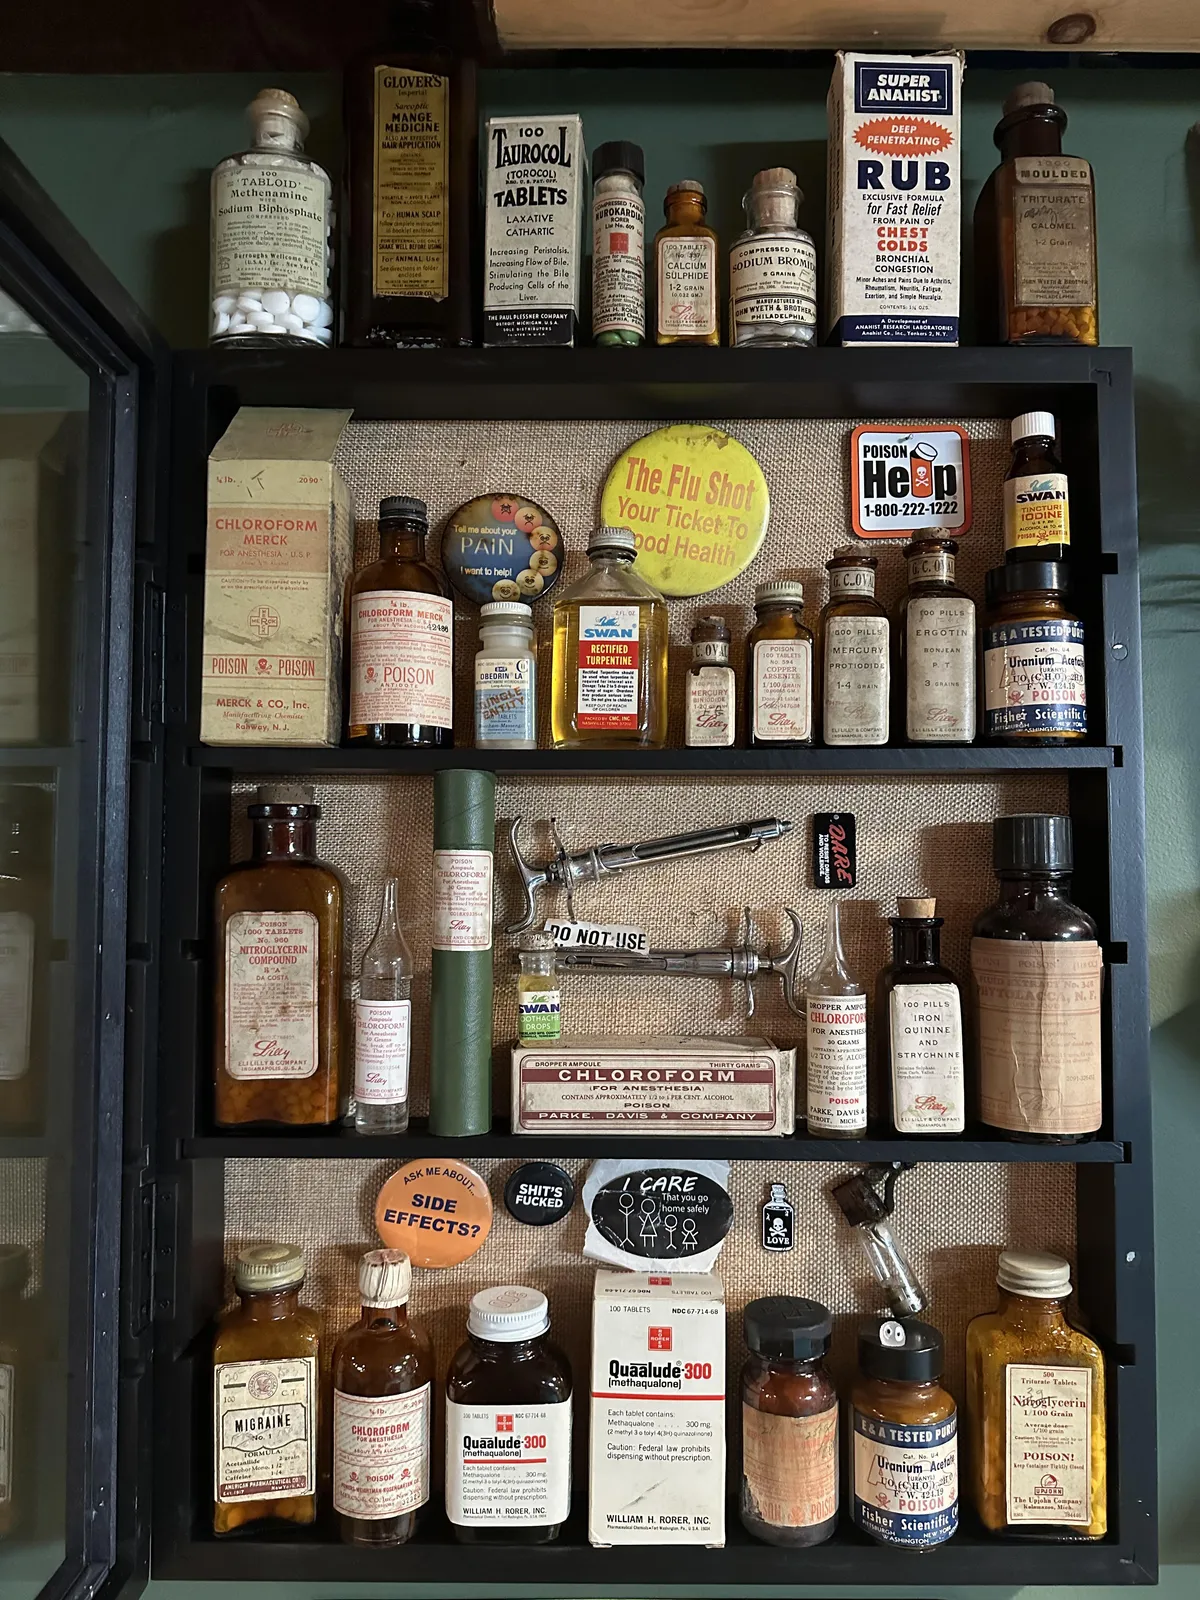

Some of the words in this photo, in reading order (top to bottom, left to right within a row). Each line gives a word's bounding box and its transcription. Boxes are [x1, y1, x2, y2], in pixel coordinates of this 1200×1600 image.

[384, 74, 441, 88] GLOVER'S
[877, 74, 930, 87] SUPER
[867, 88, 939, 102] ANAHIST
[392, 113, 432, 122] MANGE
[385, 123, 439, 132] MEDICINE
[519, 128, 544, 138] 100
[891, 124, 917, 134] DEEP
[867, 135, 940, 146] PENETRATING
[492, 127, 571, 169] TAUROCOL
[506, 169, 556, 180] (TOROCOL)
[857, 160, 951, 191] RUB
[1021, 170, 1087, 178] MOULDED
[231, 189, 308, 202] Methenamine
[494, 187, 567, 208] TABLETS
[862, 194, 903, 202] EXCLUSIVE
[906, 194, 944, 202] FORMULA
[1020, 195, 1085, 204] TRITURATE
[218, 204, 252, 217] Sodium
[258, 204, 322, 222] Biphosphate
[866, 202, 884, 215] for
[886, 202, 908, 214] Fast
[912, 202, 942, 216] Relief
[506, 214, 554, 224] LAXATIVE
[506, 228, 554, 236] CATHARTIC
[876, 227, 929, 238] CHEST
[877, 240, 928, 252] COLDS
[732, 256, 773, 273] SODIUM
[876, 254, 930, 263] BRONCHIAL
[667, 262, 706, 270] CALCIUM
[875, 265, 934, 274] CONGESTION
[665, 272, 708, 280] SULPHIDE
[752, 313, 806, 321] PHILADELPHIA.
[863, 445, 908, 458] POISON
[625, 457, 662, 495] The
[667, 464, 701, 502] Flu
[706, 471, 755, 512] Shot
[1016, 490, 1066, 504] SWAN
[864, 501, 958, 517] 1-800-222-1222
[618, 496, 660, 524] Your
[666, 504, 722, 535] Ticket
[727, 516, 748, 540] To
[1021, 511, 1062, 521] IODINE
[215, 519, 318, 532] CHLOROFORM
[454, 525, 467, 533] Tell
[480, 526, 501, 534] about
[502, 528, 518, 537] your
[243, 534, 288, 546] MERCK
[219, 550, 235, 558] FOR
[237, 550, 282, 558] ANESTHESIA
[674, 536, 737, 567] Health
[465, 568, 483, 576] want
[485, 568, 492, 576] to
[494, 568, 512, 578] help!
[359, 609, 413, 618] CHLOROFORM
[417, 611, 443, 622] MERCK
[584, 628, 633, 638] SWAN
[916, 629, 968, 637] ERGOTIN
[1021, 626, 1064, 638] TESTED
[591, 644, 628, 654] RECTIFIED
[212, 657, 248, 674] POISON
[278, 658, 314, 676] POISON
[586, 656, 632, 666] TURPENTINE
[1009, 655, 1054, 668] Uranium
[384, 666, 434, 685] POISON
[1032, 690, 1076, 702] POISON
[216, 698, 251, 708] MERCK
[256, 699, 263, 708] &
[267, 699, 288, 710] CO.,
[292, 700, 310, 709] Inc.
[994, 710, 1027, 724] Fisher
[1035, 708, 1081, 720] Scientific
[550, 924, 572, 941] DO
[576, 929, 612, 946] NOT
[616, 932, 646, 950] USE
[240, 945, 308, 954] NITROGLYCERIN
[249, 956, 297, 965] COMPOUND
[519, 1004, 560, 1013] SWAN
[810, 1002, 842, 1011] DROPPER
[914, 1014, 941, 1022] IRON
[252, 1040, 290, 1060] Lilly
[558, 1069, 736, 1082] CHLOROFORM
[589, 1084, 618, 1092] (FOR
[623, 1084, 705, 1092] ANESTHESIA)
[915, 1096, 948, 1116] Lilly
[539, 1112, 594, 1120] PARKE,
[606, 1112, 648, 1120] DAVIS
[660, 1112, 668, 1120] &
[680, 1112, 757, 1120] COMPANY
[403, 1169, 424, 1185] ASK
[426, 1167, 440, 1176] ME
[622, 1177, 630, 1191] I
[640, 1176, 698, 1192] CARE
[519, 1183, 563, 1198] SHIT'S
[411, 1193, 458, 1213] SIDE
[515, 1195, 564, 1208] FUCKED
[662, 1193, 679, 1201] That
[681, 1194, 696, 1203] you
[698, 1195, 708, 1203] go
[686, 1205, 710, 1214] safely
[384, 1209, 481, 1238] EFFECTS?
[767, 1236, 790, 1245] LOVE
[608, 1379, 682, 1390] (methaqualone)
[1013, 1395, 1086, 1409] Nitroglycerin
[235, 1414, 291, 1432] MIGRAINE
[352, 1422, 410, 1436] CHLOROFORM
[862, 1419, 867, 1430] E
[869, 1424, 876, 1435] &
[878, 1427, 886, 1438] A
[890, 1429, 933, 1442] TESTED
[462, 1450, 522, 1458] (methaqualone)
[607, 1443, 636, 1451] Caution:
[638, 1443, 663, 1452] Federal
[681, 1445, 710, 1454] prohibits
[607, 1453, 643, 1462] dispensing
[645, 1454, 670, 1462] without
[670, 1454, 712, 1463] prescription.
[1024, 1452, 1074, 1462] POISON!
[878, 1456, 923, 1473] Uranium
[899, 1496, 944, 1512] POISON
[1028, 1497, 1052, 1505] Upjohn
[1053, 1497, 1082, 1505] Company
[606, 1514, 643, 1524] WILLIAM
[648, 1515, 656, 1524] H.
[659, 1516, 691, 1525] RORER,
[694, 1516, 711, 1524] INC.
[862, 1505, 894, 1528] Fisher
[901, 1514, 949, 1531] Scientific
